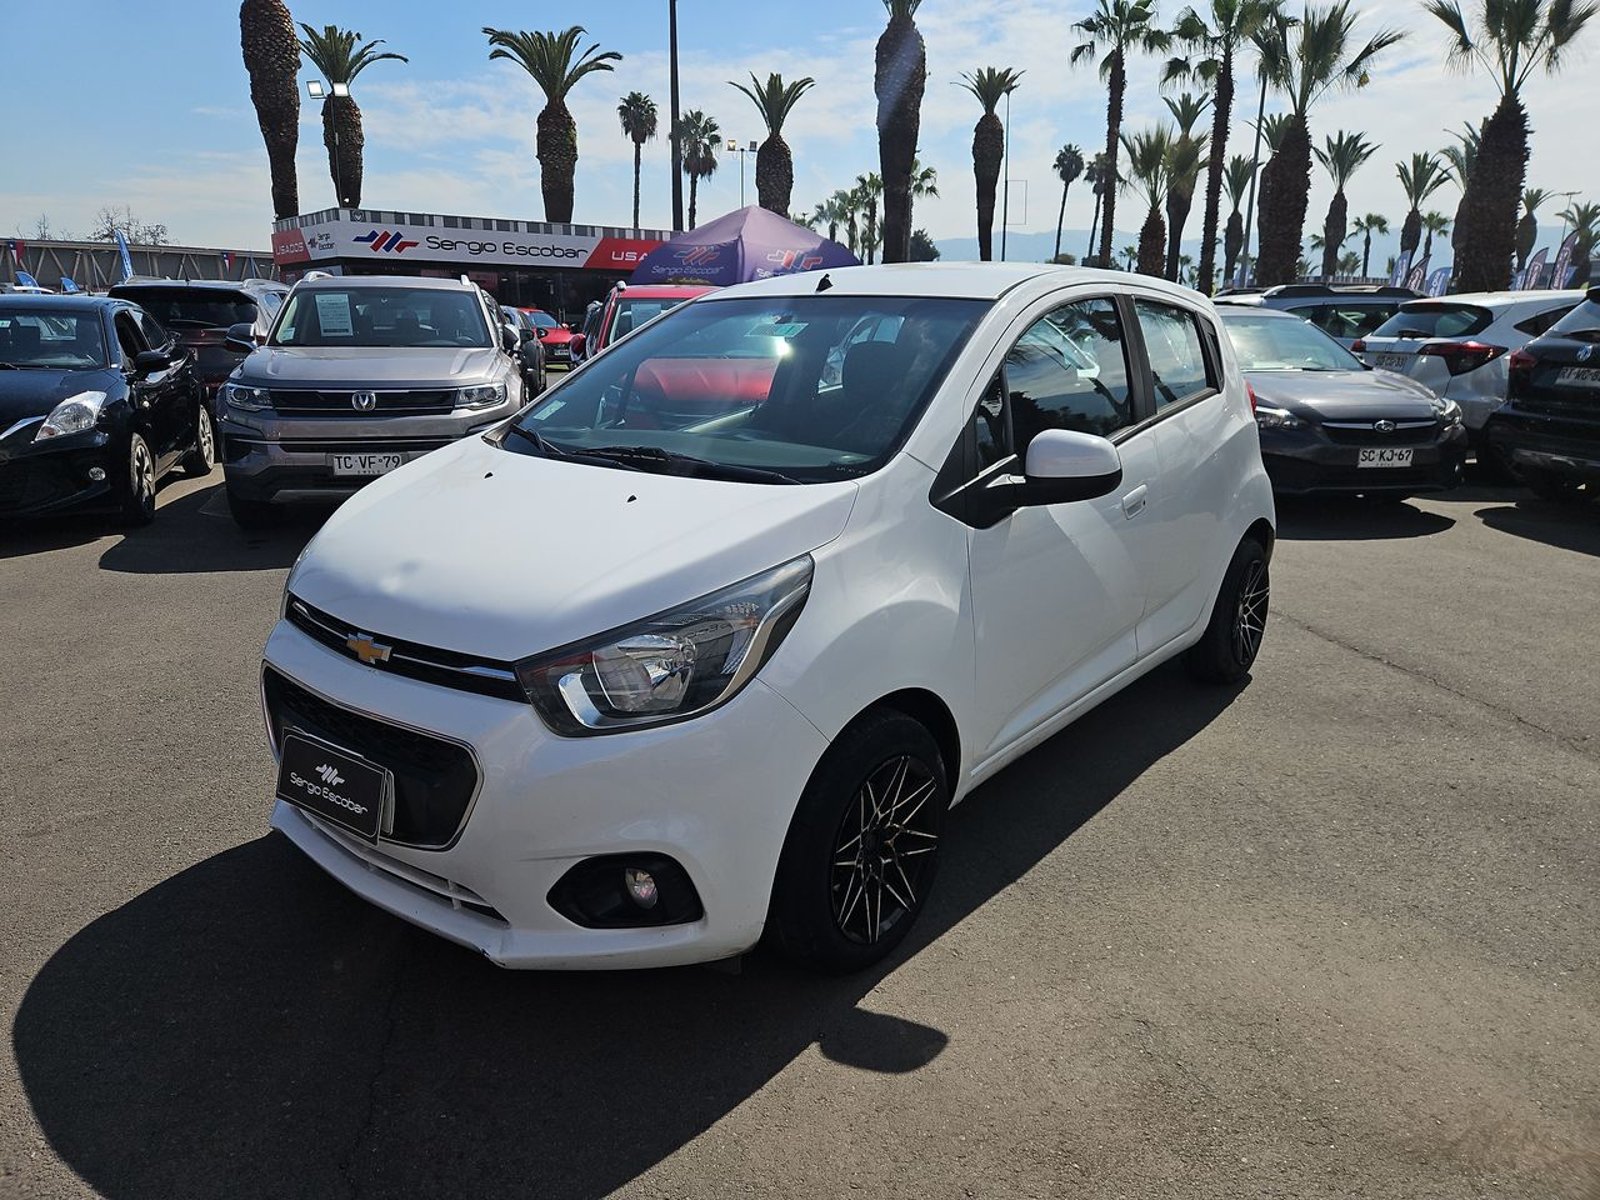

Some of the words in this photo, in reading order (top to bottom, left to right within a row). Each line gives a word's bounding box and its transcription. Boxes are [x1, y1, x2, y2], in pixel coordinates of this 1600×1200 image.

[275, 241, 304, 255] USADOS
[425, 235, 497, 255] Sergio
[503, 242, 588, 258] Escobar
[322, 786, 368, 815] Escobar
